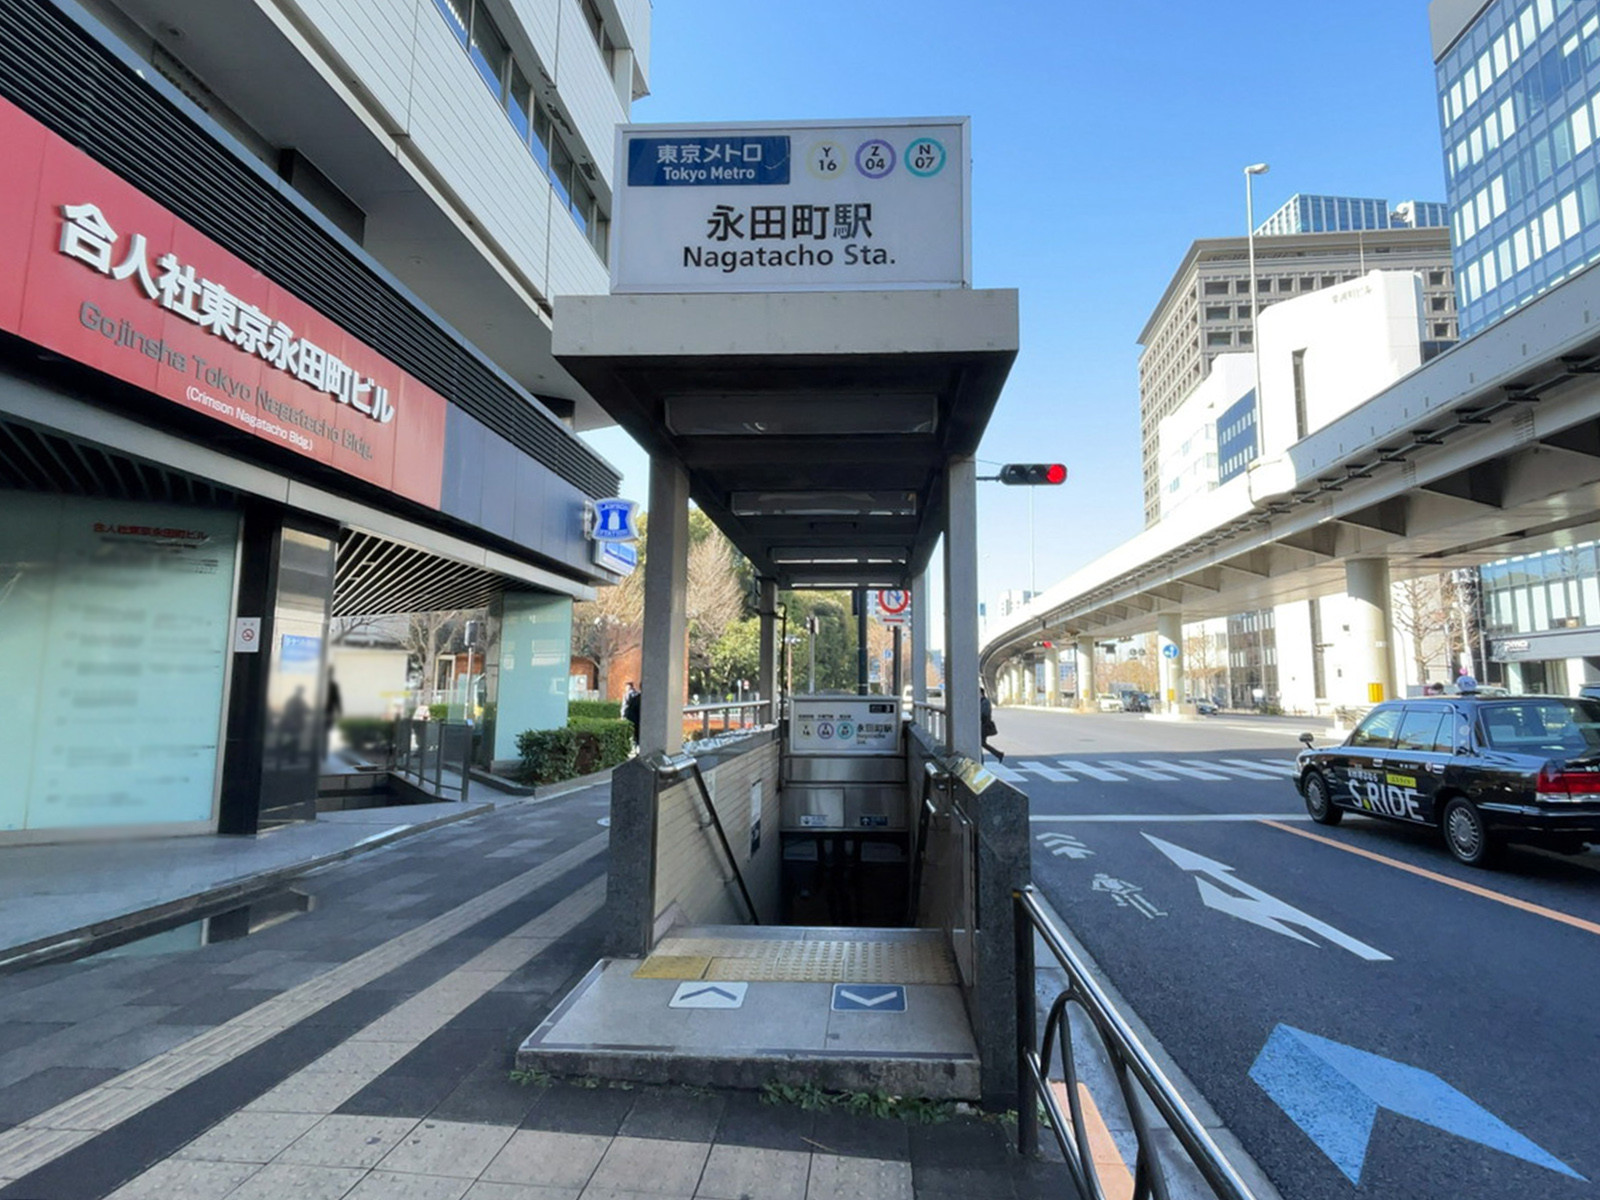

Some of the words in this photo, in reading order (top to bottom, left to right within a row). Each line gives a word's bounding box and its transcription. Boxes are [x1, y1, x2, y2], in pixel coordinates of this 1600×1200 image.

[657, 144, 762, 165] 東京メトロ
[822, 147, 831, 157] Y
[871, 146, 879, 157] Z
[919, 144, 930, 155] N
[818, 159, 837, 171] 16
[865, 158, 885, 170] 04
[915, 157, 935, 169] 07
[663, 167, 707, 182] Tokyo
[711, 166, 755, 181] Metro
[706, 203, 872, 241] 永田町駅
[683, 245, 833, 272] Nagatacho
[844, 244, 896, 265] Sta.
[59, 203, 395, 423] 合人社東京永田町ビル
[79, 301, 187, 372] Gojinsha
[192, 354, 251, 400] Tokyo
[256, 387, 339, 442] Nagatacho
[186, 385, 234, 417] (Crimson
[235, 407, 288, 440] Nagatacho
[1347, 778, 1425, 822] S.RIDE
